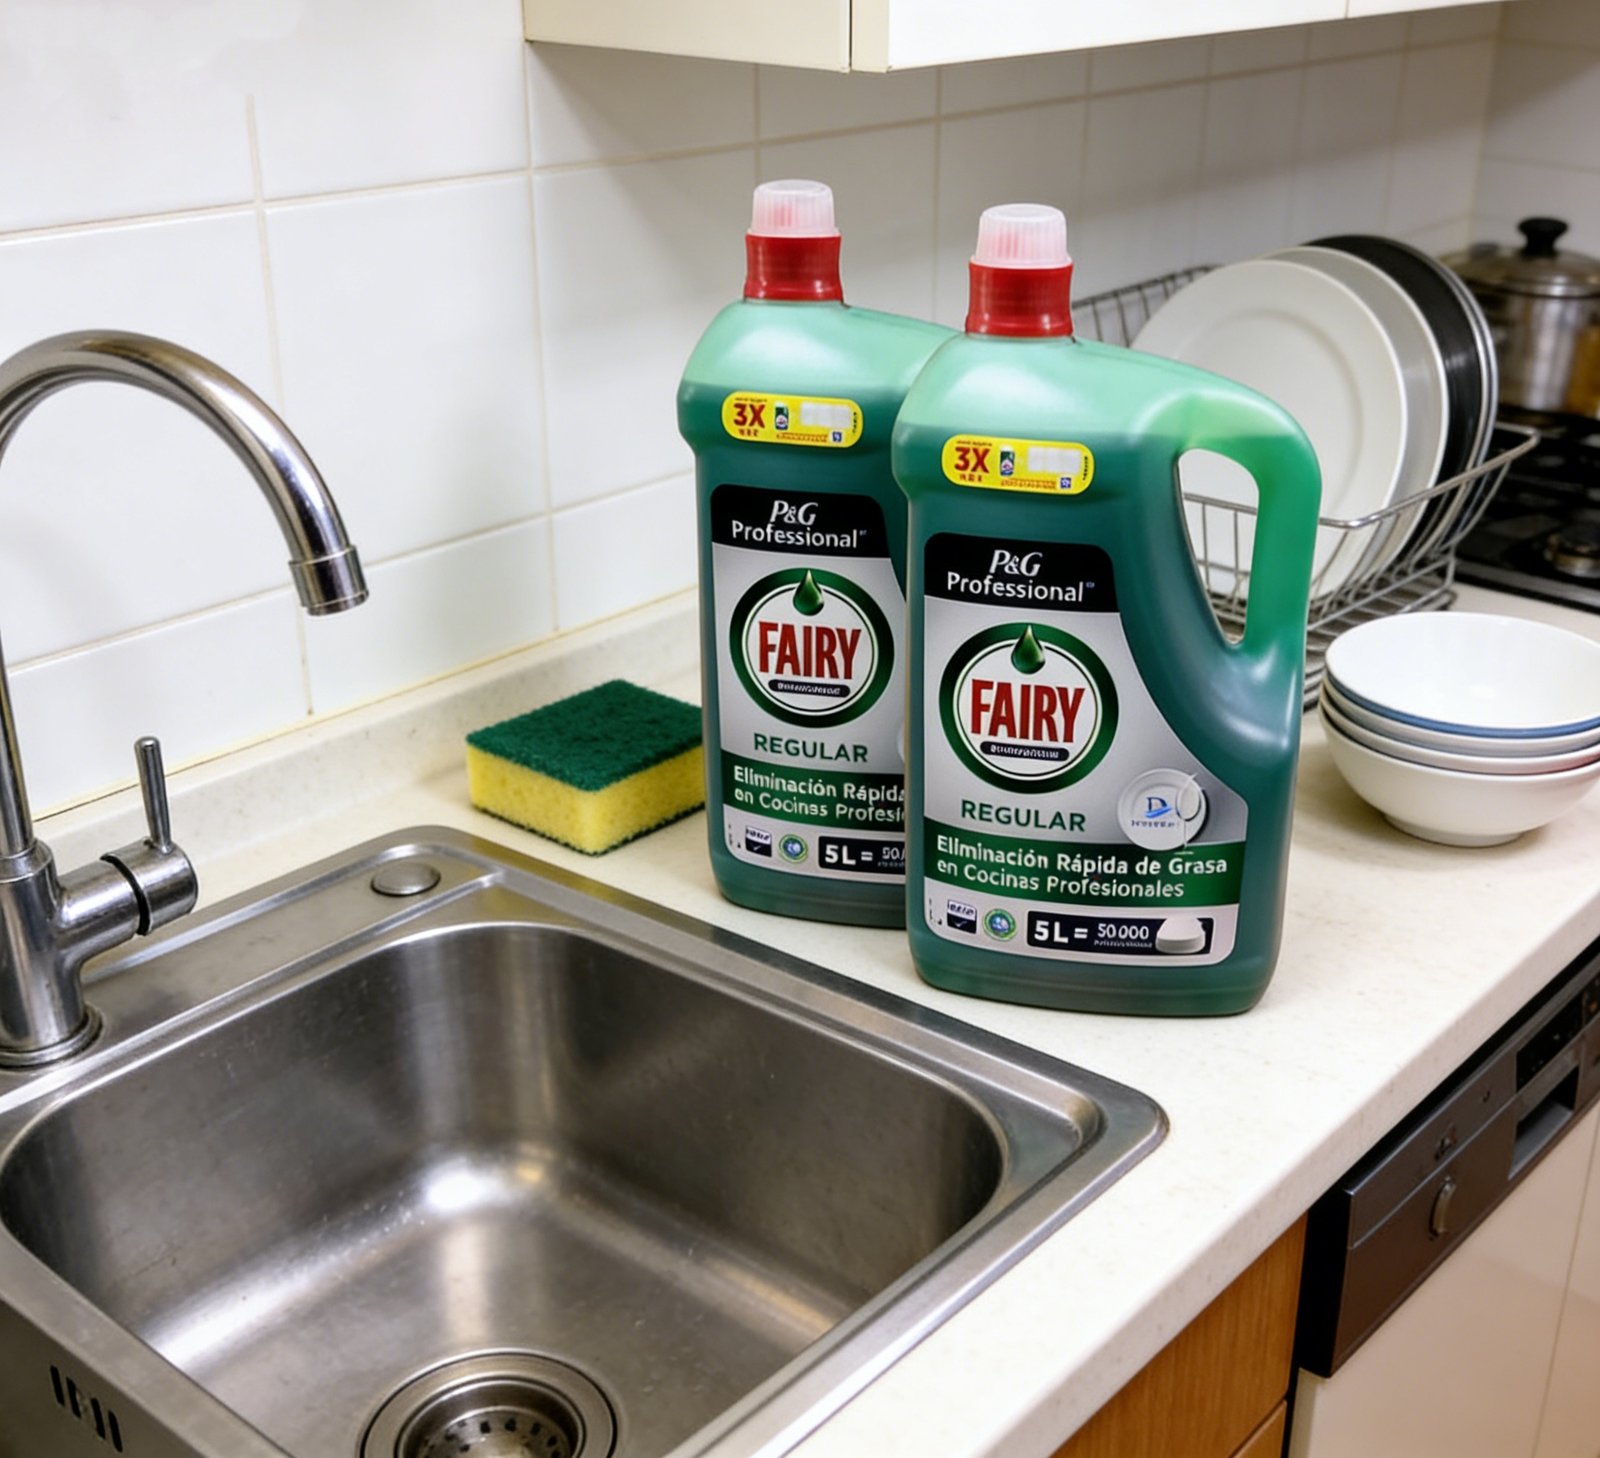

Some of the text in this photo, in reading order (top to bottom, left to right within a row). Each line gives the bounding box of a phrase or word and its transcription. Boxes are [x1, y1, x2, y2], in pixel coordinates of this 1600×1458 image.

[733, 403, 766, 429] 3X
[954, 446, 991, 474] 3X
[769, 500, 819, 526] P&G
[731, 520, 858, 549] Professional
[988, 549, 1044, 577] P&G
[947, 571, 1084, 602] Professional
[758, 620, 862, 680] FAIRY
[971, 678, 1086, 743] FAIRY
[754, 732, 868, 763] REGULAR
[734, 765, 837, 797] Eliminación
[961, 799, 1086, 832] REGULAR
[936, 834, 1228, 877] Eliminación Rápida de Grasa
[937, 859, 1185, 898] en Cocinas Profesionales
